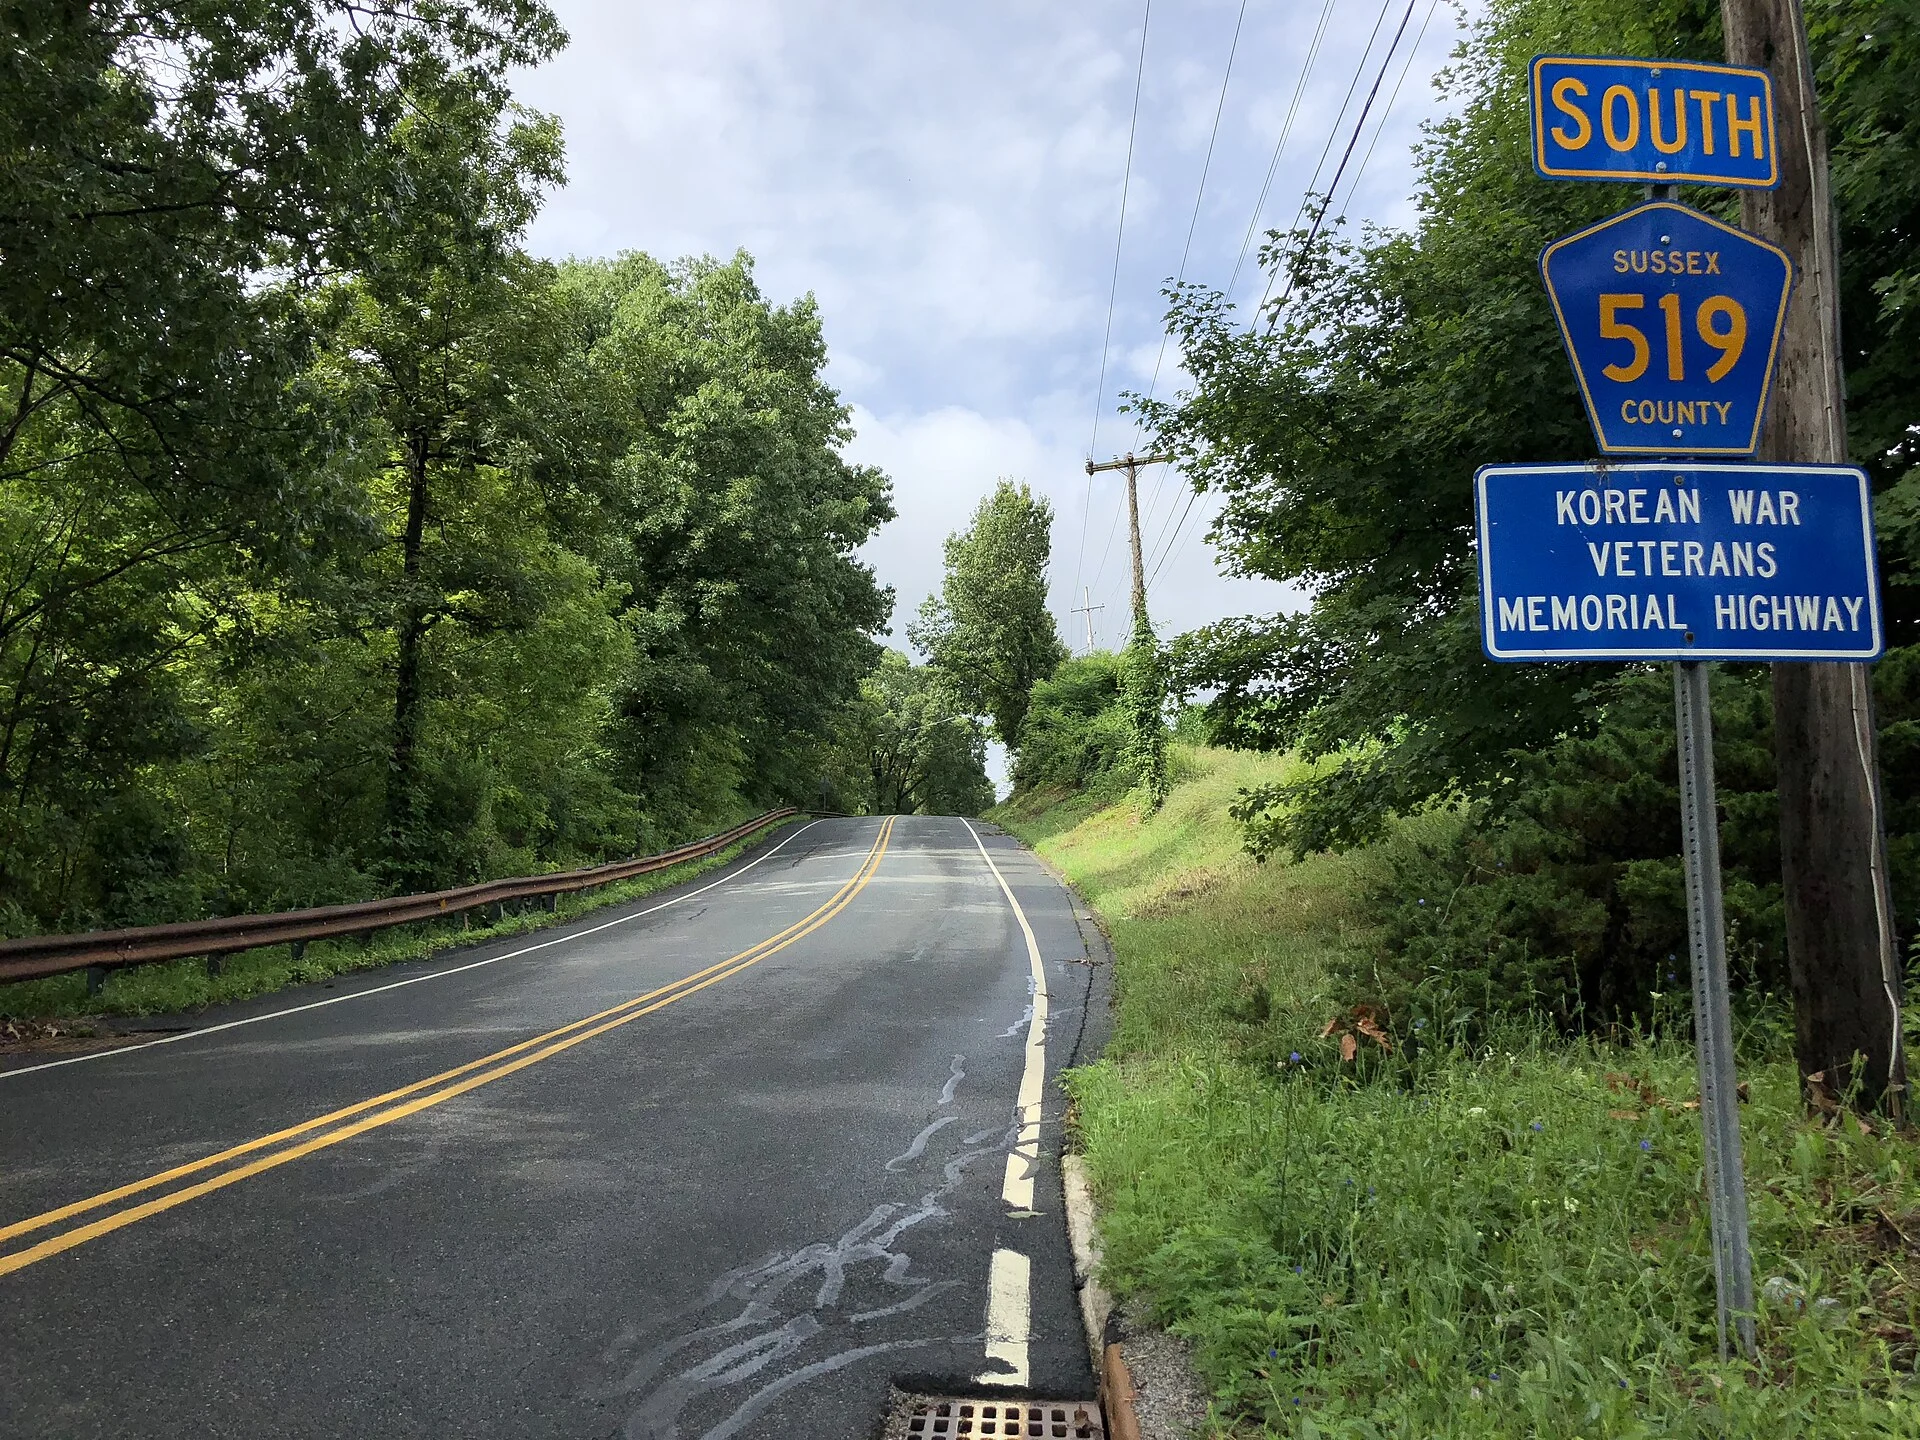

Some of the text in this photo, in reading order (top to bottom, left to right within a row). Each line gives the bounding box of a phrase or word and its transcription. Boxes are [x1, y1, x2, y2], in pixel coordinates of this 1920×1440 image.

[1550, 77, 1765, 160] SOUTH
[1613, 249, 1721, 275] SUSSEX
[1599, 293, 1747, 384] 519
[1621, 399, 1732, 425] COUNTY
[1556, 488, 1801, 526] KOREAN WAR
[1586, 541, 1777, 578] VETERANS
[1498, 594, 1864, 632] MEMORIAL HIGHWAY
